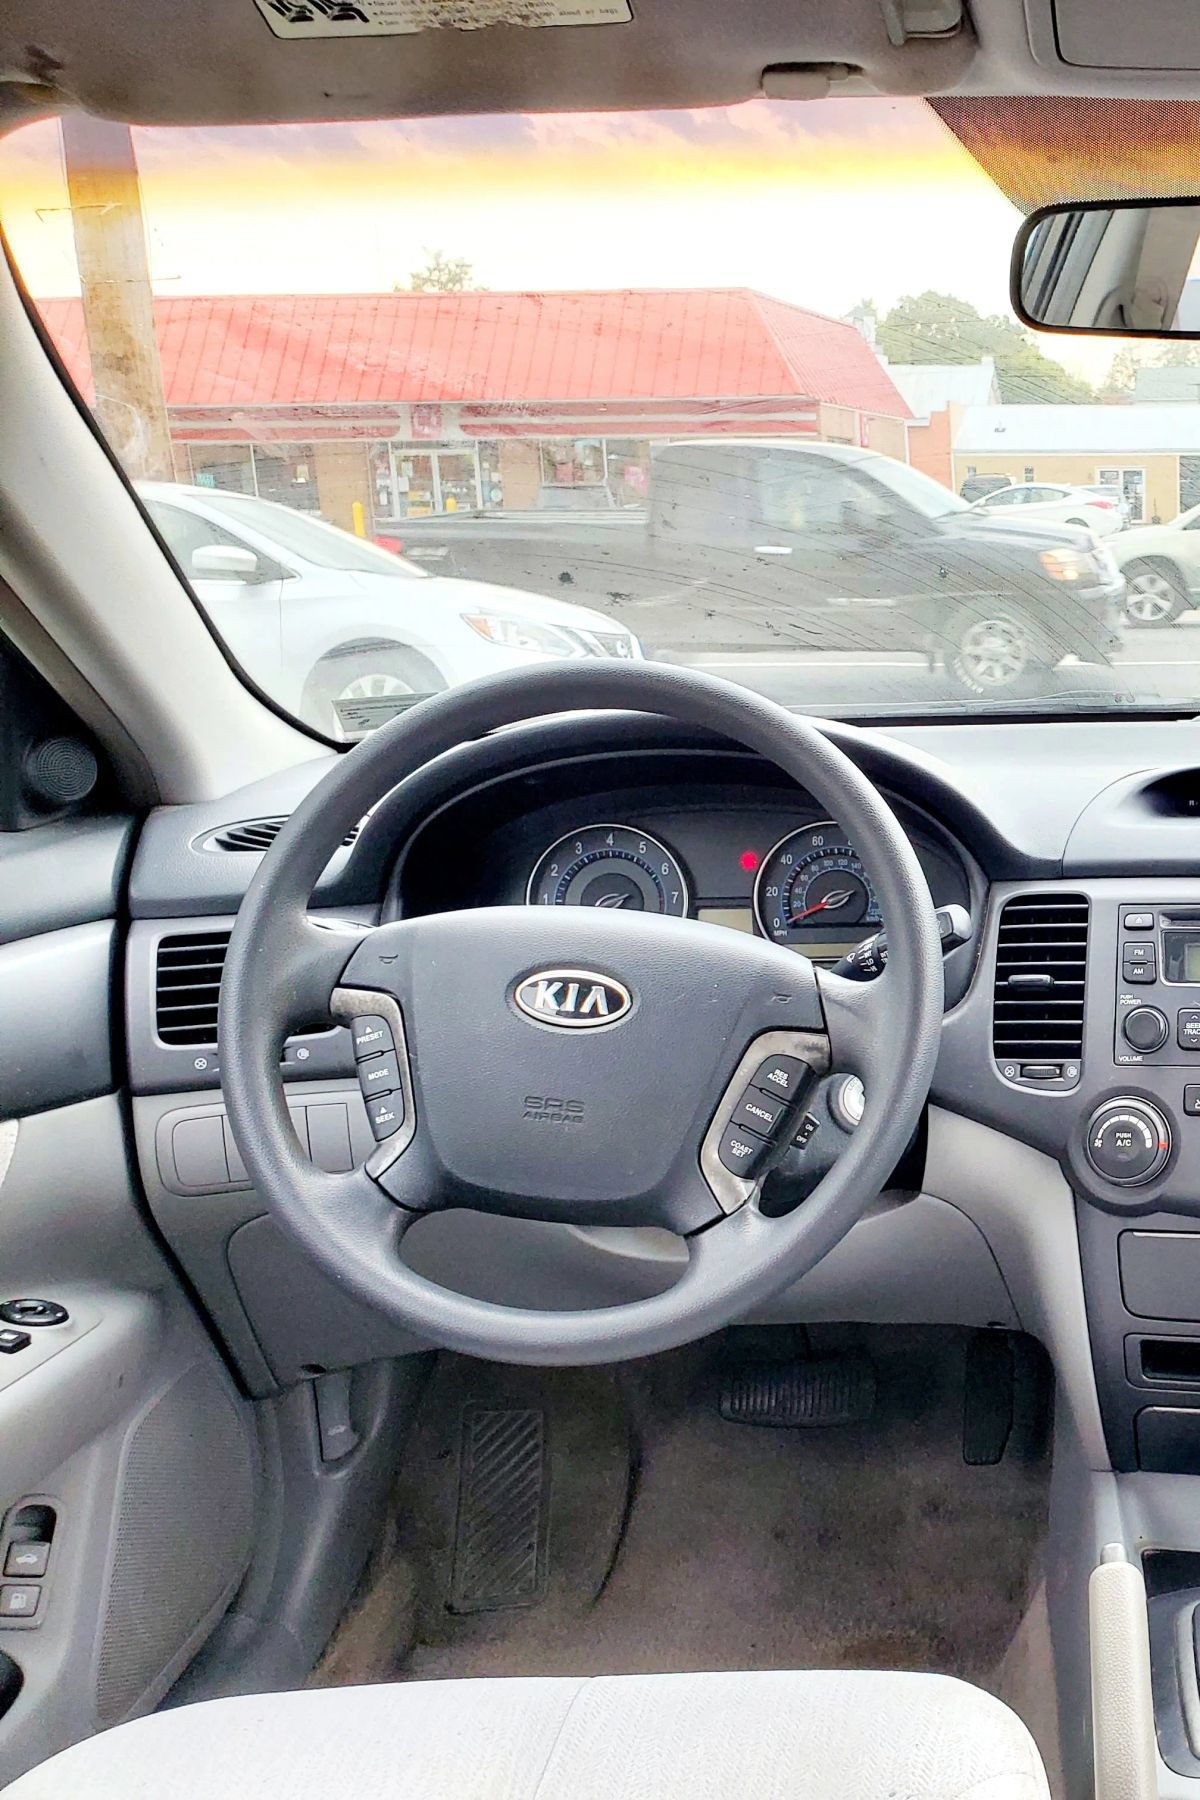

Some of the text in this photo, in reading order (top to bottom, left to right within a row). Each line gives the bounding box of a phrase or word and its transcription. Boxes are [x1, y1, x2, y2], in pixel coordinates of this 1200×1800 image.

[606, 832, 614, 846] 4
[812, 836, 824, 846] 60
[575, 842, 583, 855] 3
[639, 841, 647, 854] 5
[781, 854, 793, 865] 40
[550, 864, 559, 877] 2
[661, 862, 670, 875] 6
[671, 891, 679, 904] 7
[766, 886, 778, 897] 20
[543, 893, 549, 905] 1
[773, 918, 780, 928] 0
[534, 980, 609, 1015] KIA
[356, 1030, 384, 1045] PRESET
[368, 1068, 389, 1081] MODE
[767, 1073, 789, 1088] ACCEL
[774, 1069, 789, 1080] RES
[523, 1096, 585, 1113] SRS
[375, 1111, 395, 1124] SEEK
[522, 1110, 585, 1124] AIRBAG
[745, 1103, 774, 1122] CANCEL
[805, 1123, 814, 1131] ON
[730, 1139, 753, 1155] COAST
[1116, 1138, 1132, 1147] A/C
[731, 1147, 746, 1158] SET
